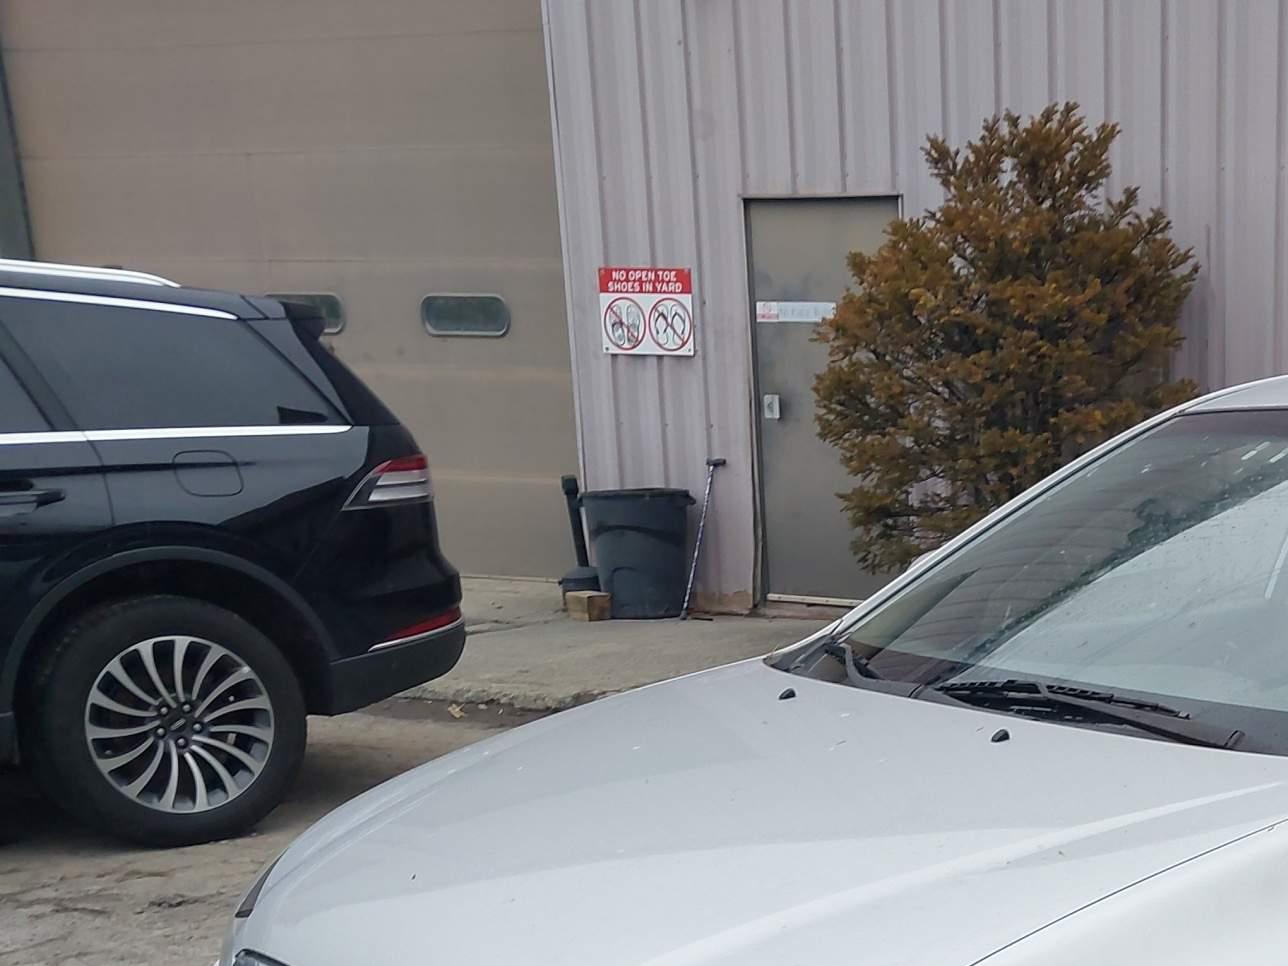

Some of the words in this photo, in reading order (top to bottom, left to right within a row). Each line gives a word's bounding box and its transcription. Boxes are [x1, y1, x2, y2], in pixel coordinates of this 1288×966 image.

[612, 270, 626, 281] NO
[628, 270, 655, 281] OPEN
[657, 270, 677, 281] TOE
[607, 282, 640, 292] SHOES
[642, 283, 653, 292] IN
[655, 283, 682, 292] YARD
